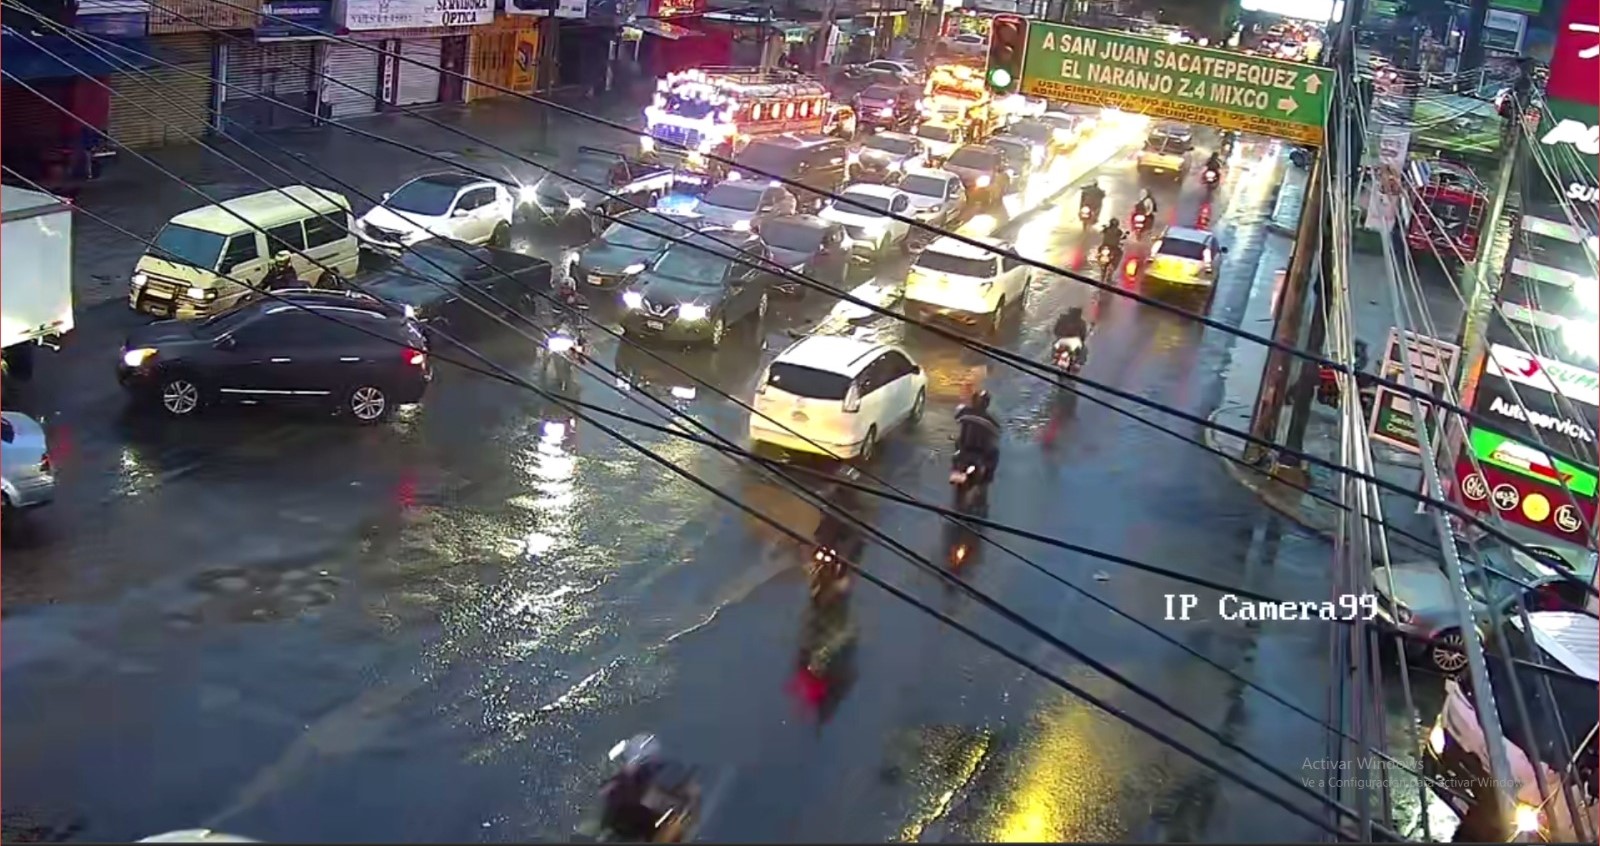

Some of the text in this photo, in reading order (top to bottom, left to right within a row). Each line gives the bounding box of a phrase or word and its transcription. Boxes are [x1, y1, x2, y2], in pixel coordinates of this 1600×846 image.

[1042, 32, 1298, 90] A SAN JUAN SACATEPEQUEZ
[1061, 59, 1269, 110] EL NARANJO Z.4 MIXCO
